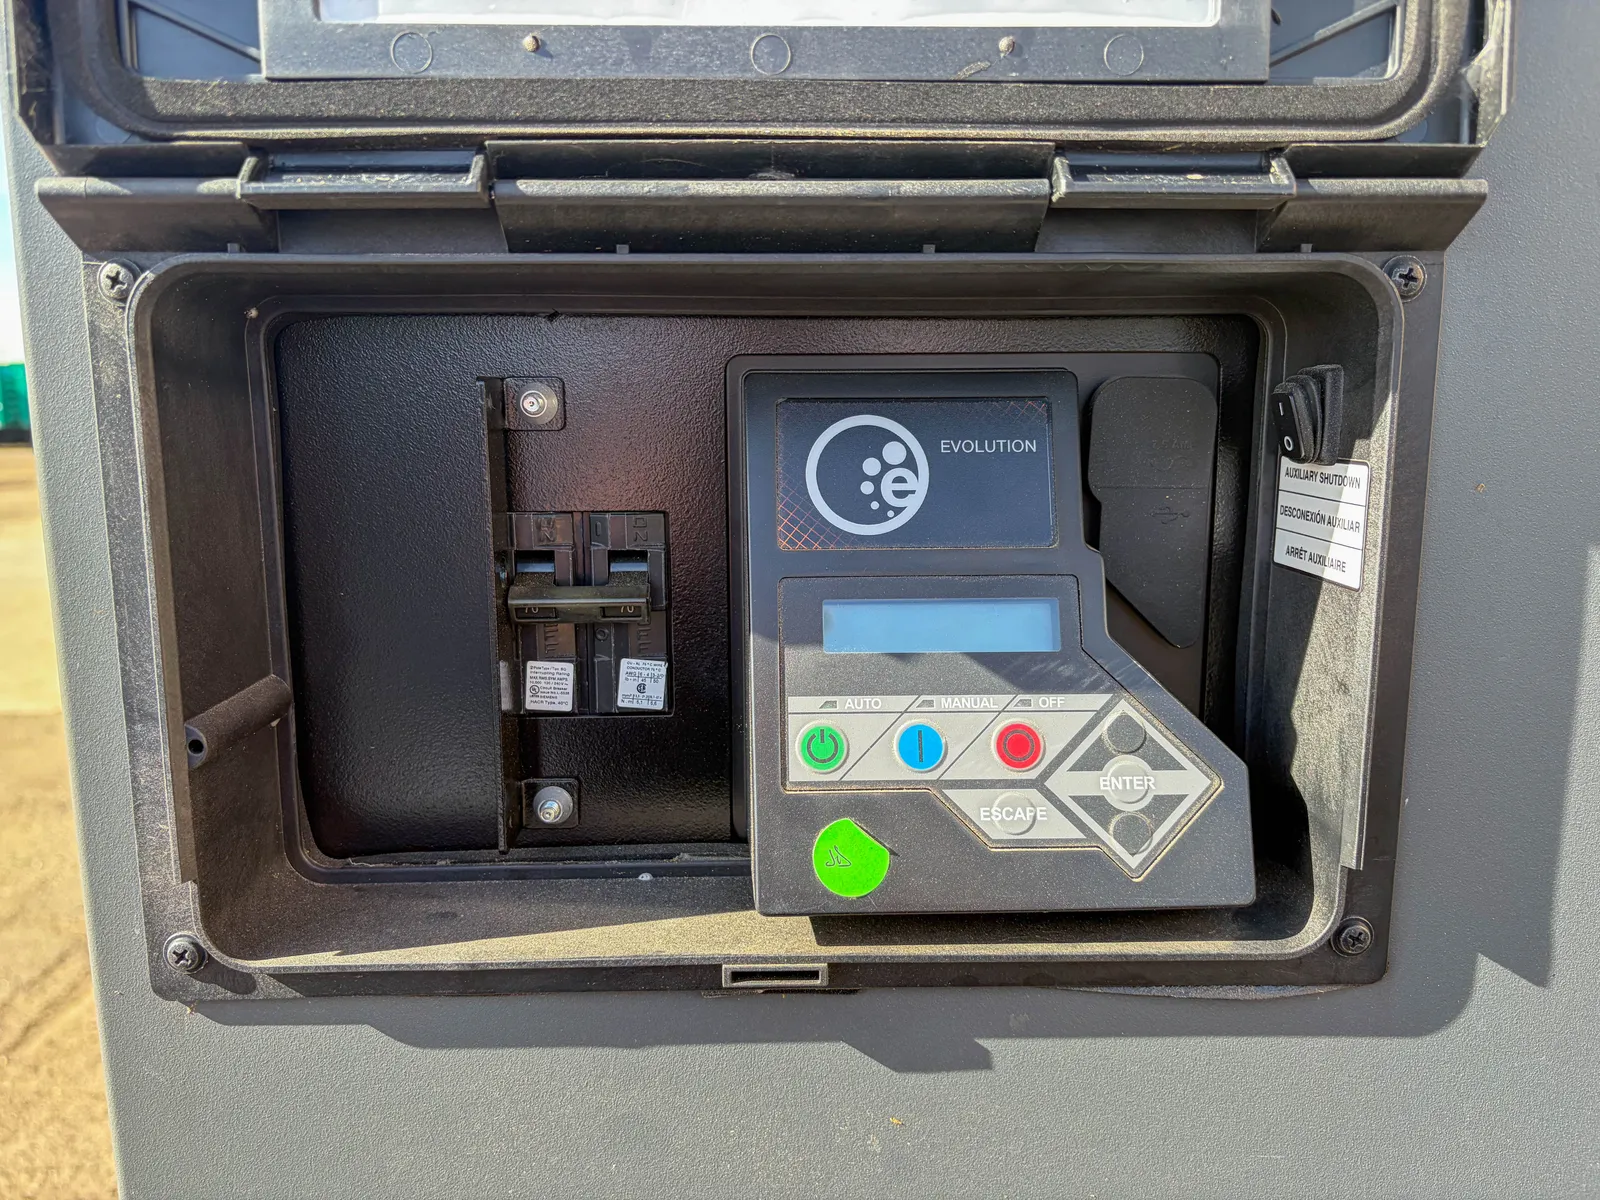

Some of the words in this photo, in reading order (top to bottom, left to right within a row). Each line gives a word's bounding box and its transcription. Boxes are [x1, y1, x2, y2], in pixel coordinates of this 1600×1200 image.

[940, 439, 1037, 453] EVOLUTION
[1284, 466, 1318, 483] AUXILIARY
[1319, 472, 1361, 490] SHUTDOWN
[1280, 504, 1326, 526] DESCONEXIÓN
[1326, 515, 1361, 534] AUXILIAR
[1285, 544, 1307, 562] ARRÊT
[1308, 553, 1346, 573] AUXILIAIRE
[844, 697, 882, 710] AUTO
[941, 696, 998, 709] MANUAL
[1038, 696, 1065, 709] OFF
[1099, 776, 1156, 790] ENTER
[980, 806, 1048, 821] ESCAPE
